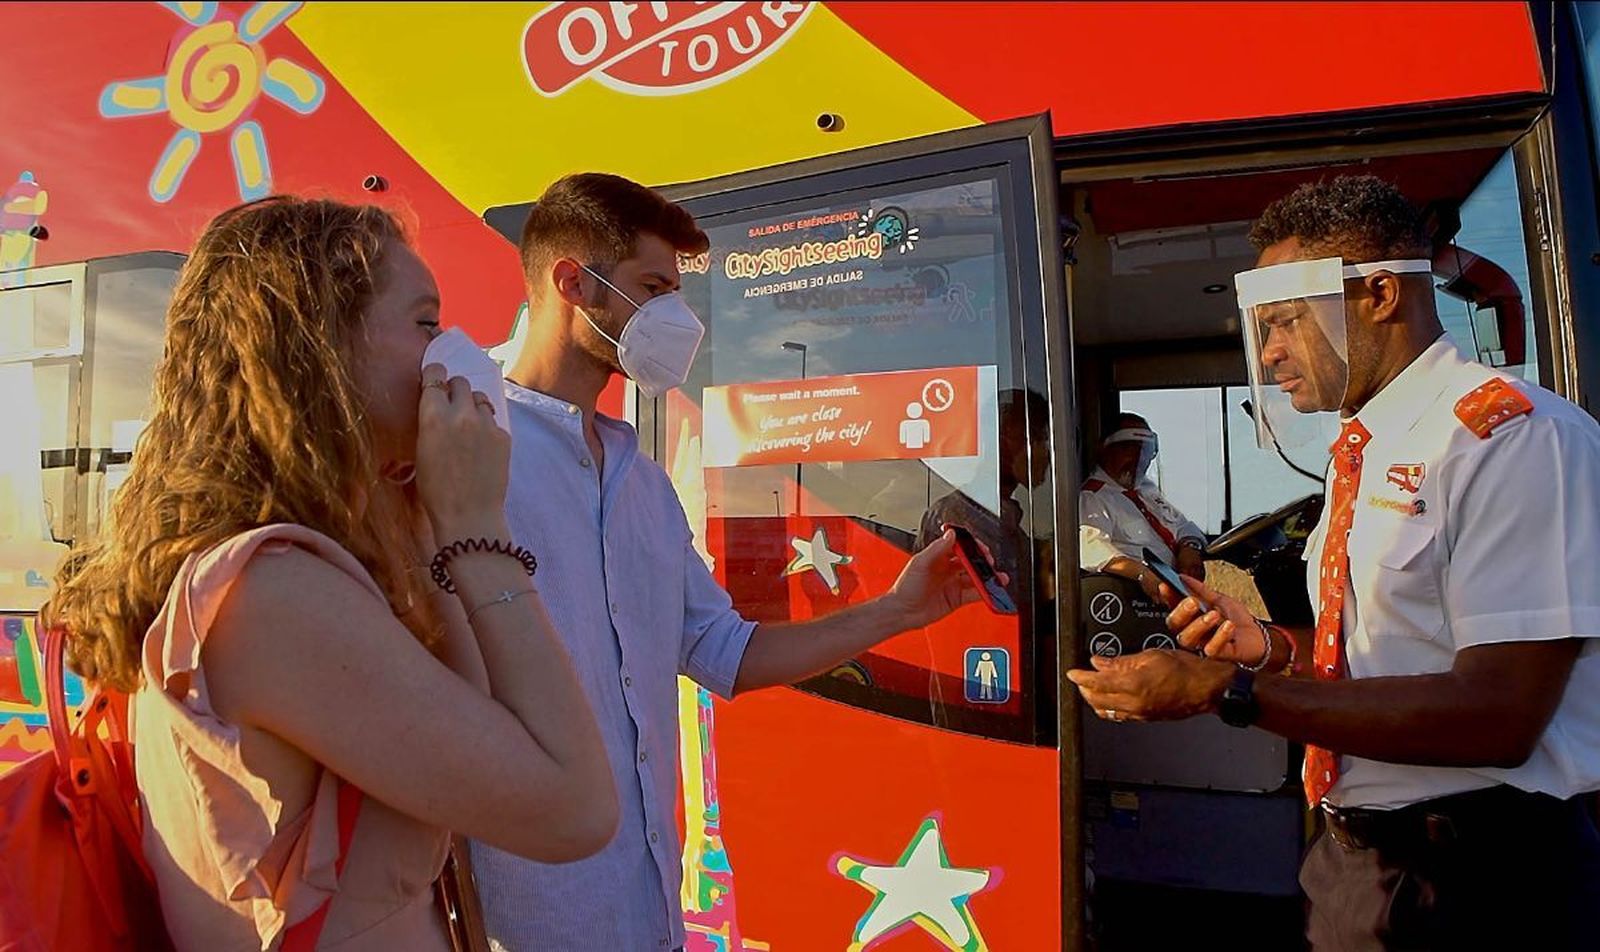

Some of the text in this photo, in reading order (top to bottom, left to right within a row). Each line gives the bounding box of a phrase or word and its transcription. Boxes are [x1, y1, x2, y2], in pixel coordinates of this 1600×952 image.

[659, 2, 803, 76] TOUR
[748, 224, 781, 237] SALIDA
[782, 221, 796, 231] DE
[725, 232, 883, 280] CitySightseeing
[742, 386, 860, 404] Please wait a moment.
[760, 405, 842, 433] You are close
[815, 426, 836, 443] the
[839, 420, 872, 446] city!
